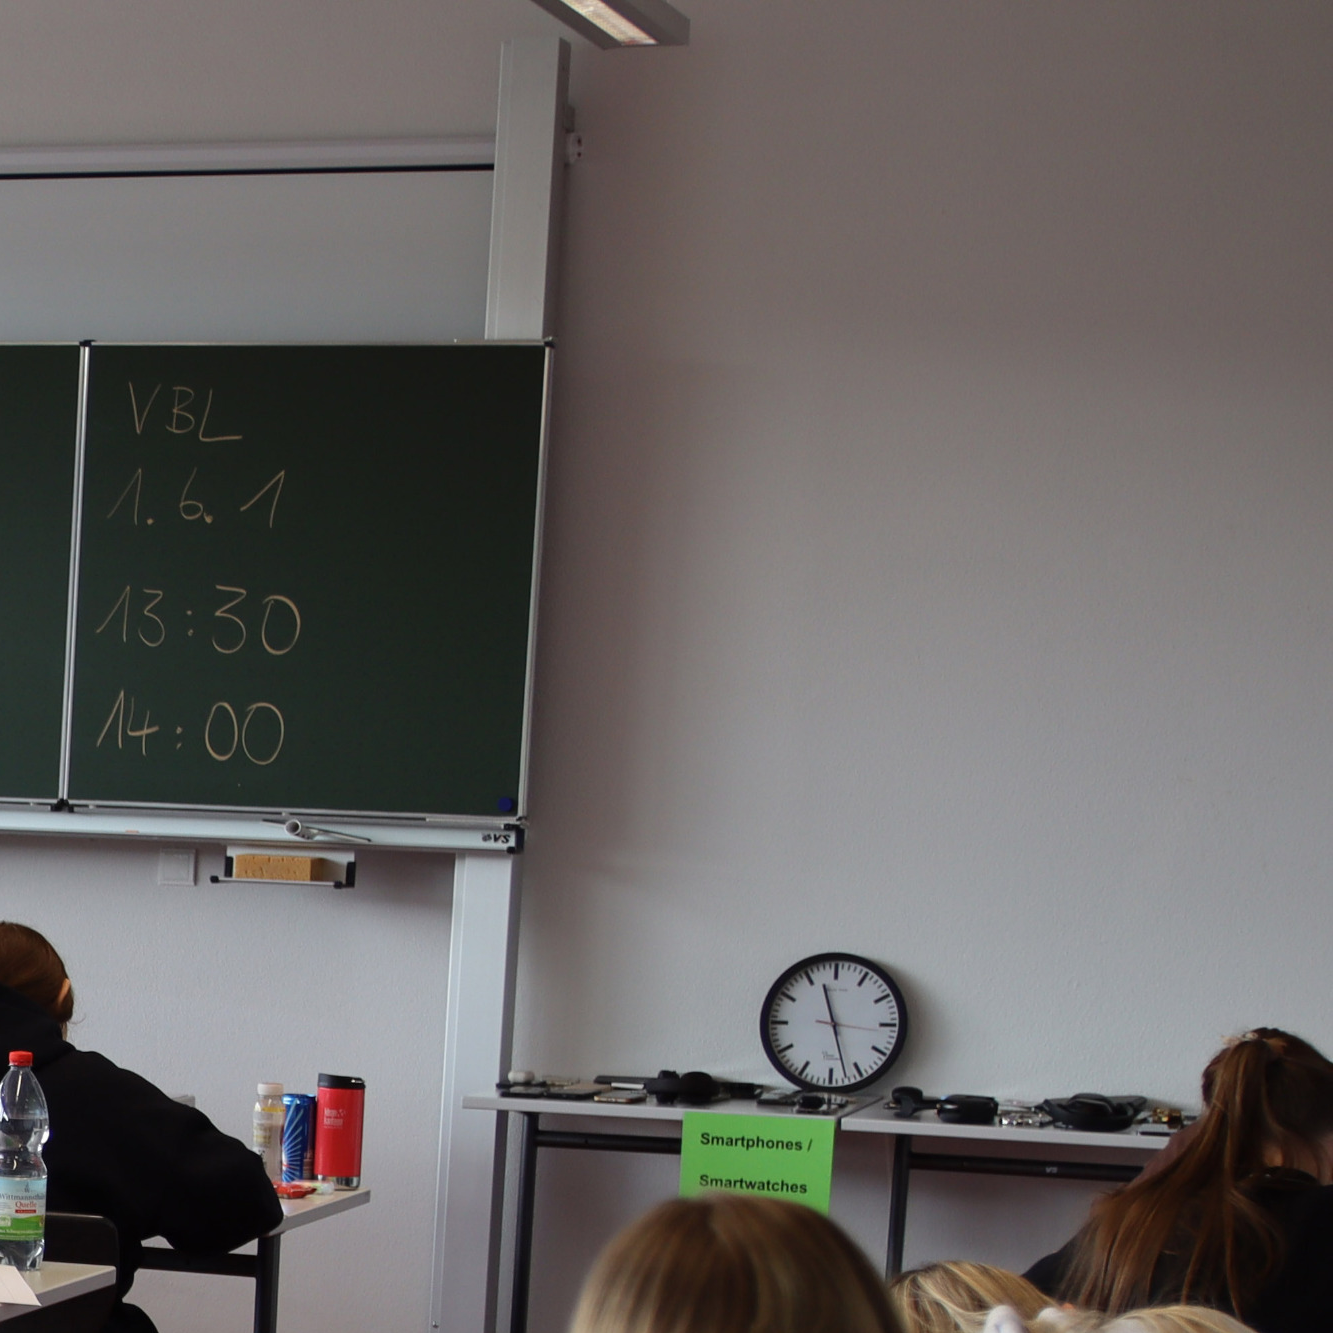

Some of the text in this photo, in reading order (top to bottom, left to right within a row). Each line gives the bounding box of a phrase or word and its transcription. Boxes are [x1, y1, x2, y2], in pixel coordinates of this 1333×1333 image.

[129, 381, 242, 441] VBL
[96, 585, 301, 655] 13:30
[97, 690, 285, 765] 14:00
[700, 1132, 813, 1153] Smartphones /
[699, 1174, 808, 1194] Smartwatches
